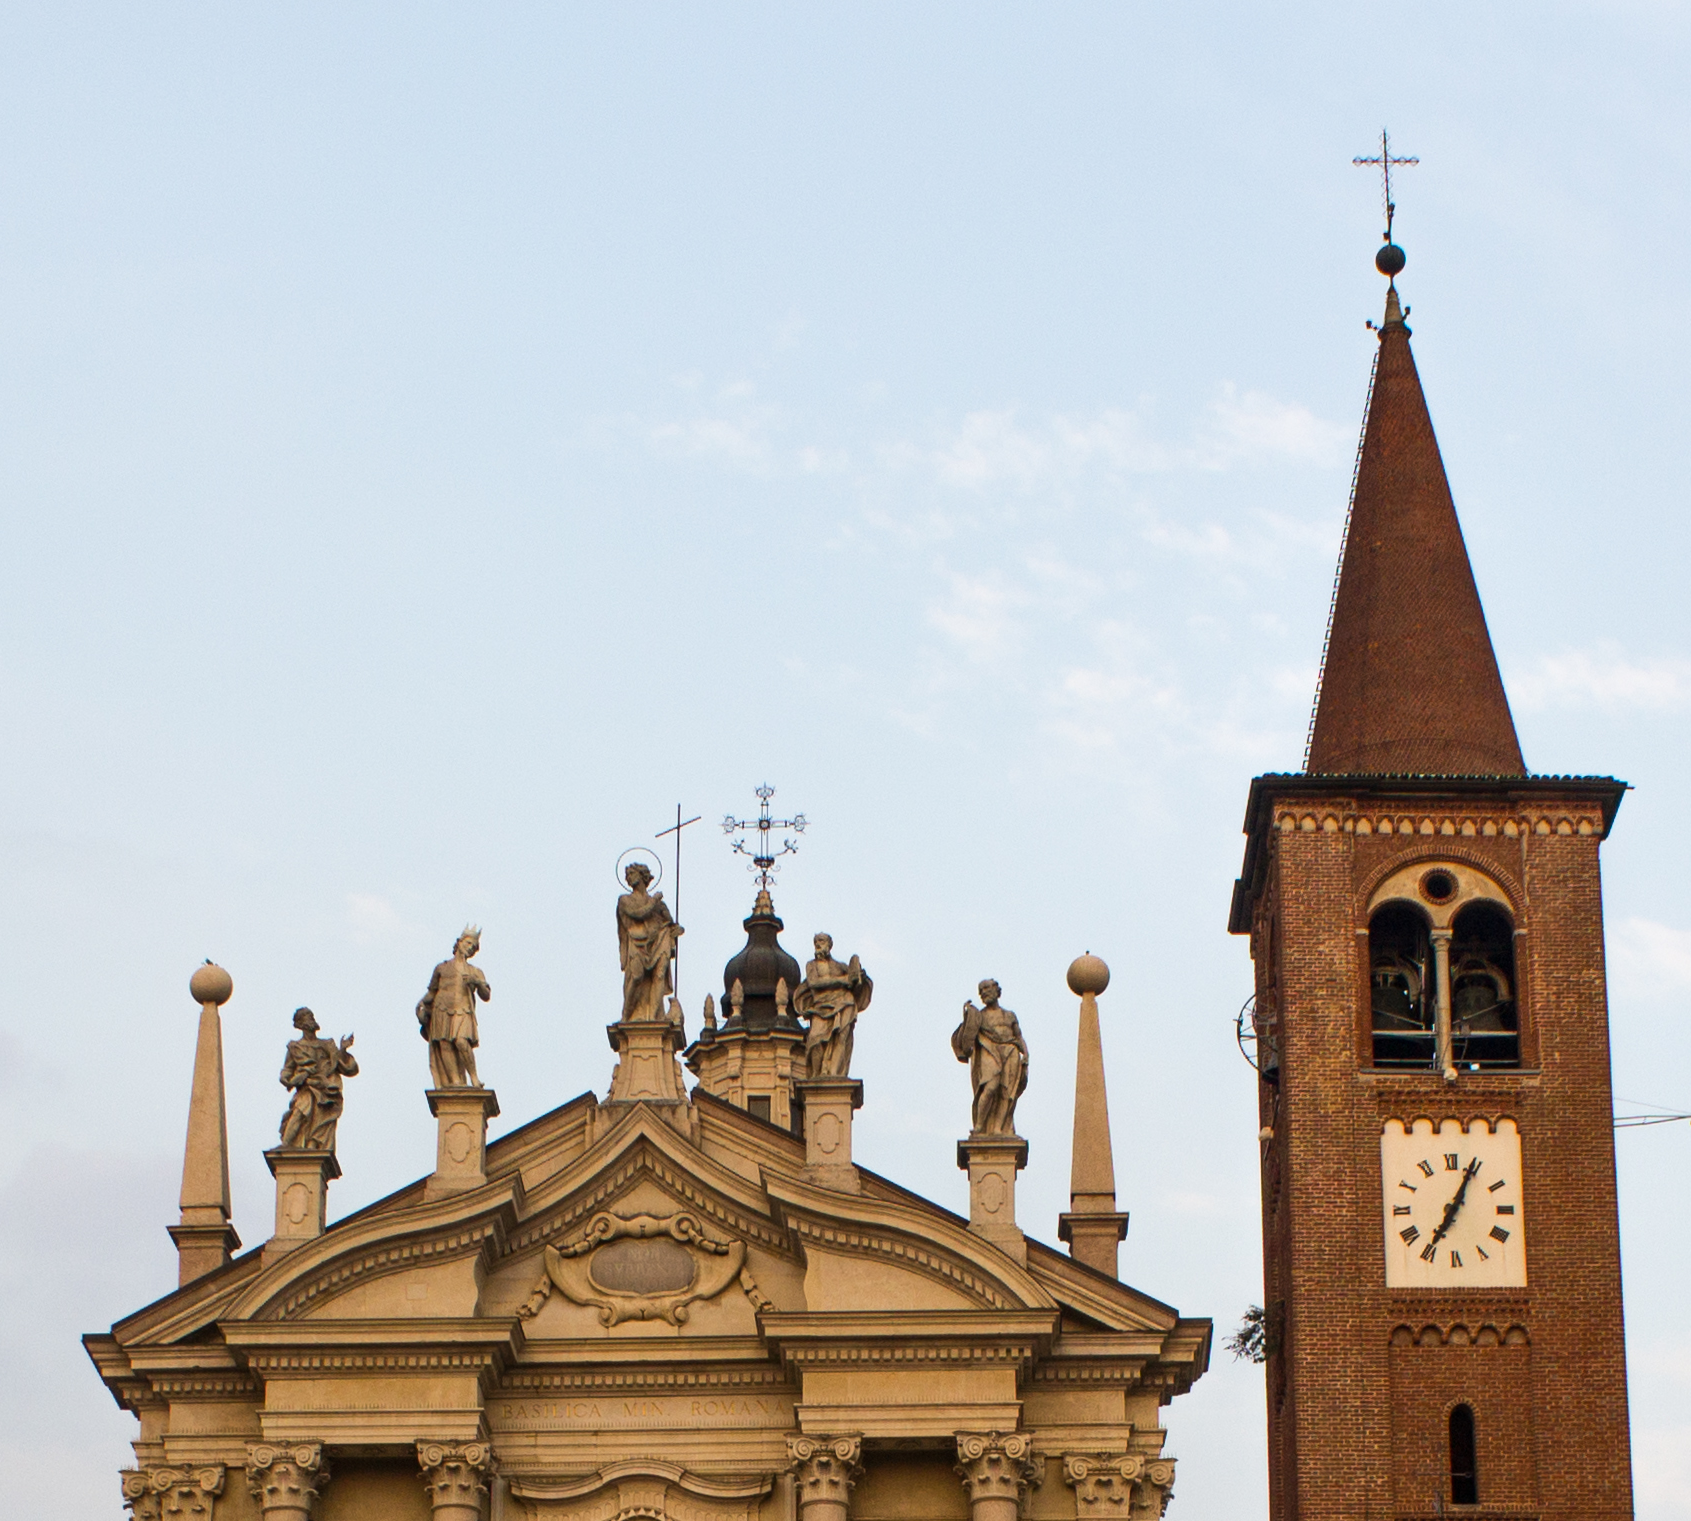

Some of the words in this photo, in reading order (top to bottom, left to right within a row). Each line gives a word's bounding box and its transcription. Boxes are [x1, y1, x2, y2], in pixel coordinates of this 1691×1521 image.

[1444, 1153, 1458, 1170] XII
[1399, 1180, 1417, 1193] X
[1487, 1179, 1505, 1193] II
[1496, 1205, 1514, 1215] III
[1451, 1250, 1463, 1267] VI
[1476, 1245, 1489, 1262] V
[503, 1403, 602, 1419] BASILICA
[623, 1401, 671, 1417] MIN.
[691, 1400, 787, 1417] ROMANA
